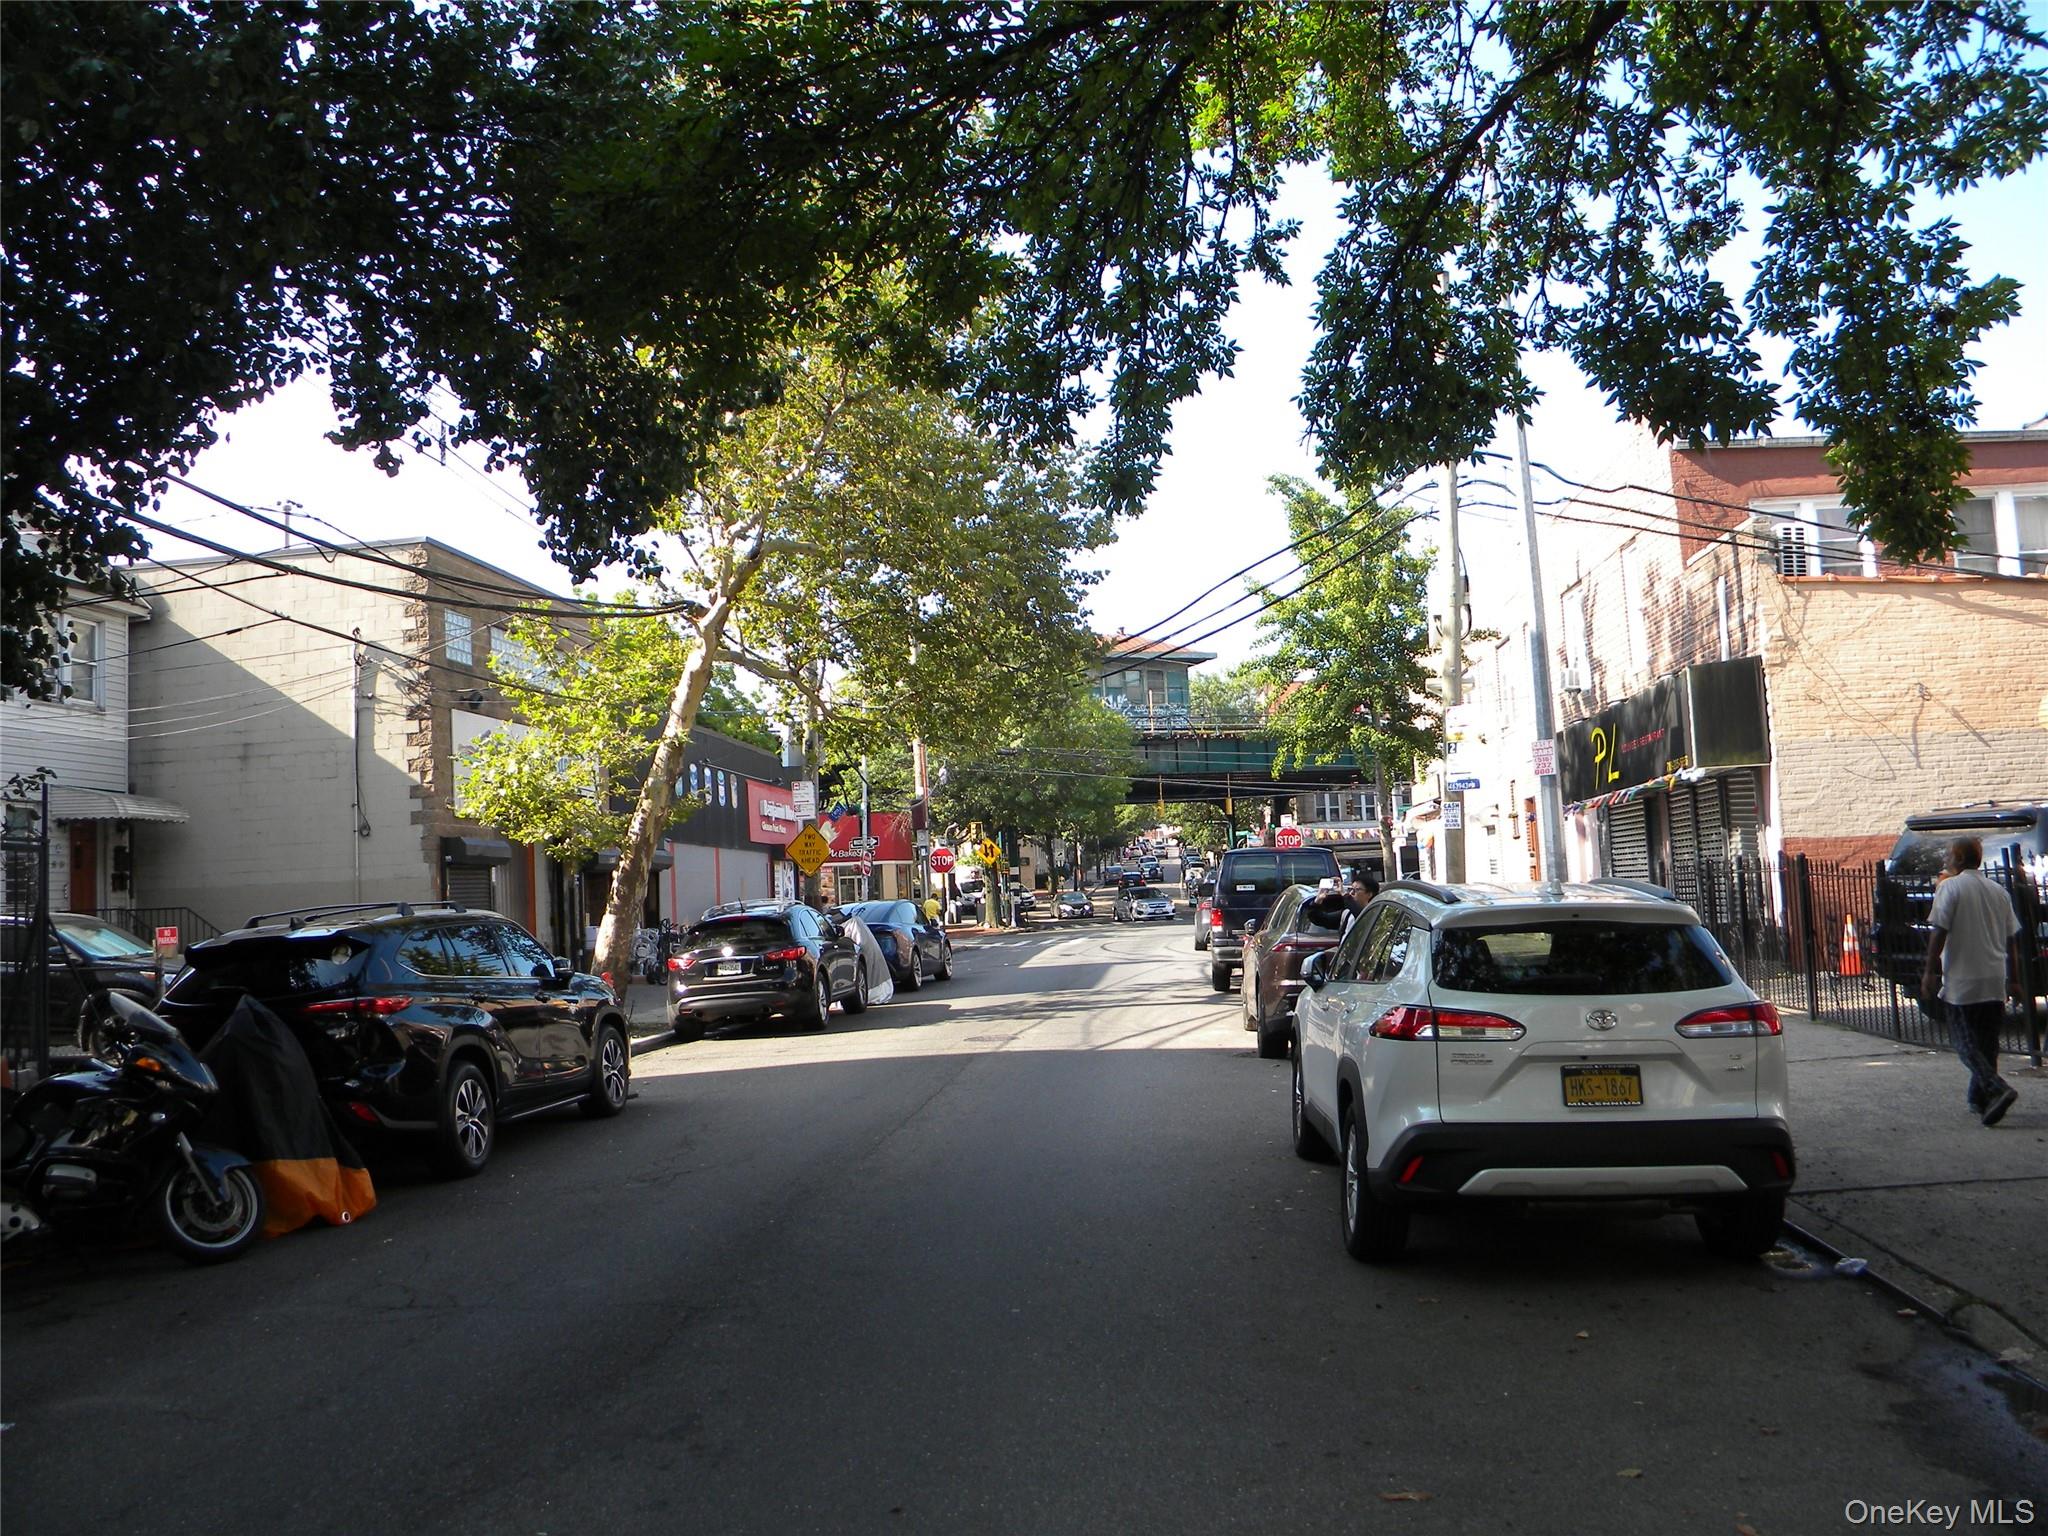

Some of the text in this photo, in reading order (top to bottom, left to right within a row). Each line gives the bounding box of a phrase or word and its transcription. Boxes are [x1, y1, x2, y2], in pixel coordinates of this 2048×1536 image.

[1277, 834, 1301, 846] STOP
[931, 855, 953, 866] STOP
[1569, 1077, 1633, 1097] HKS-1867
